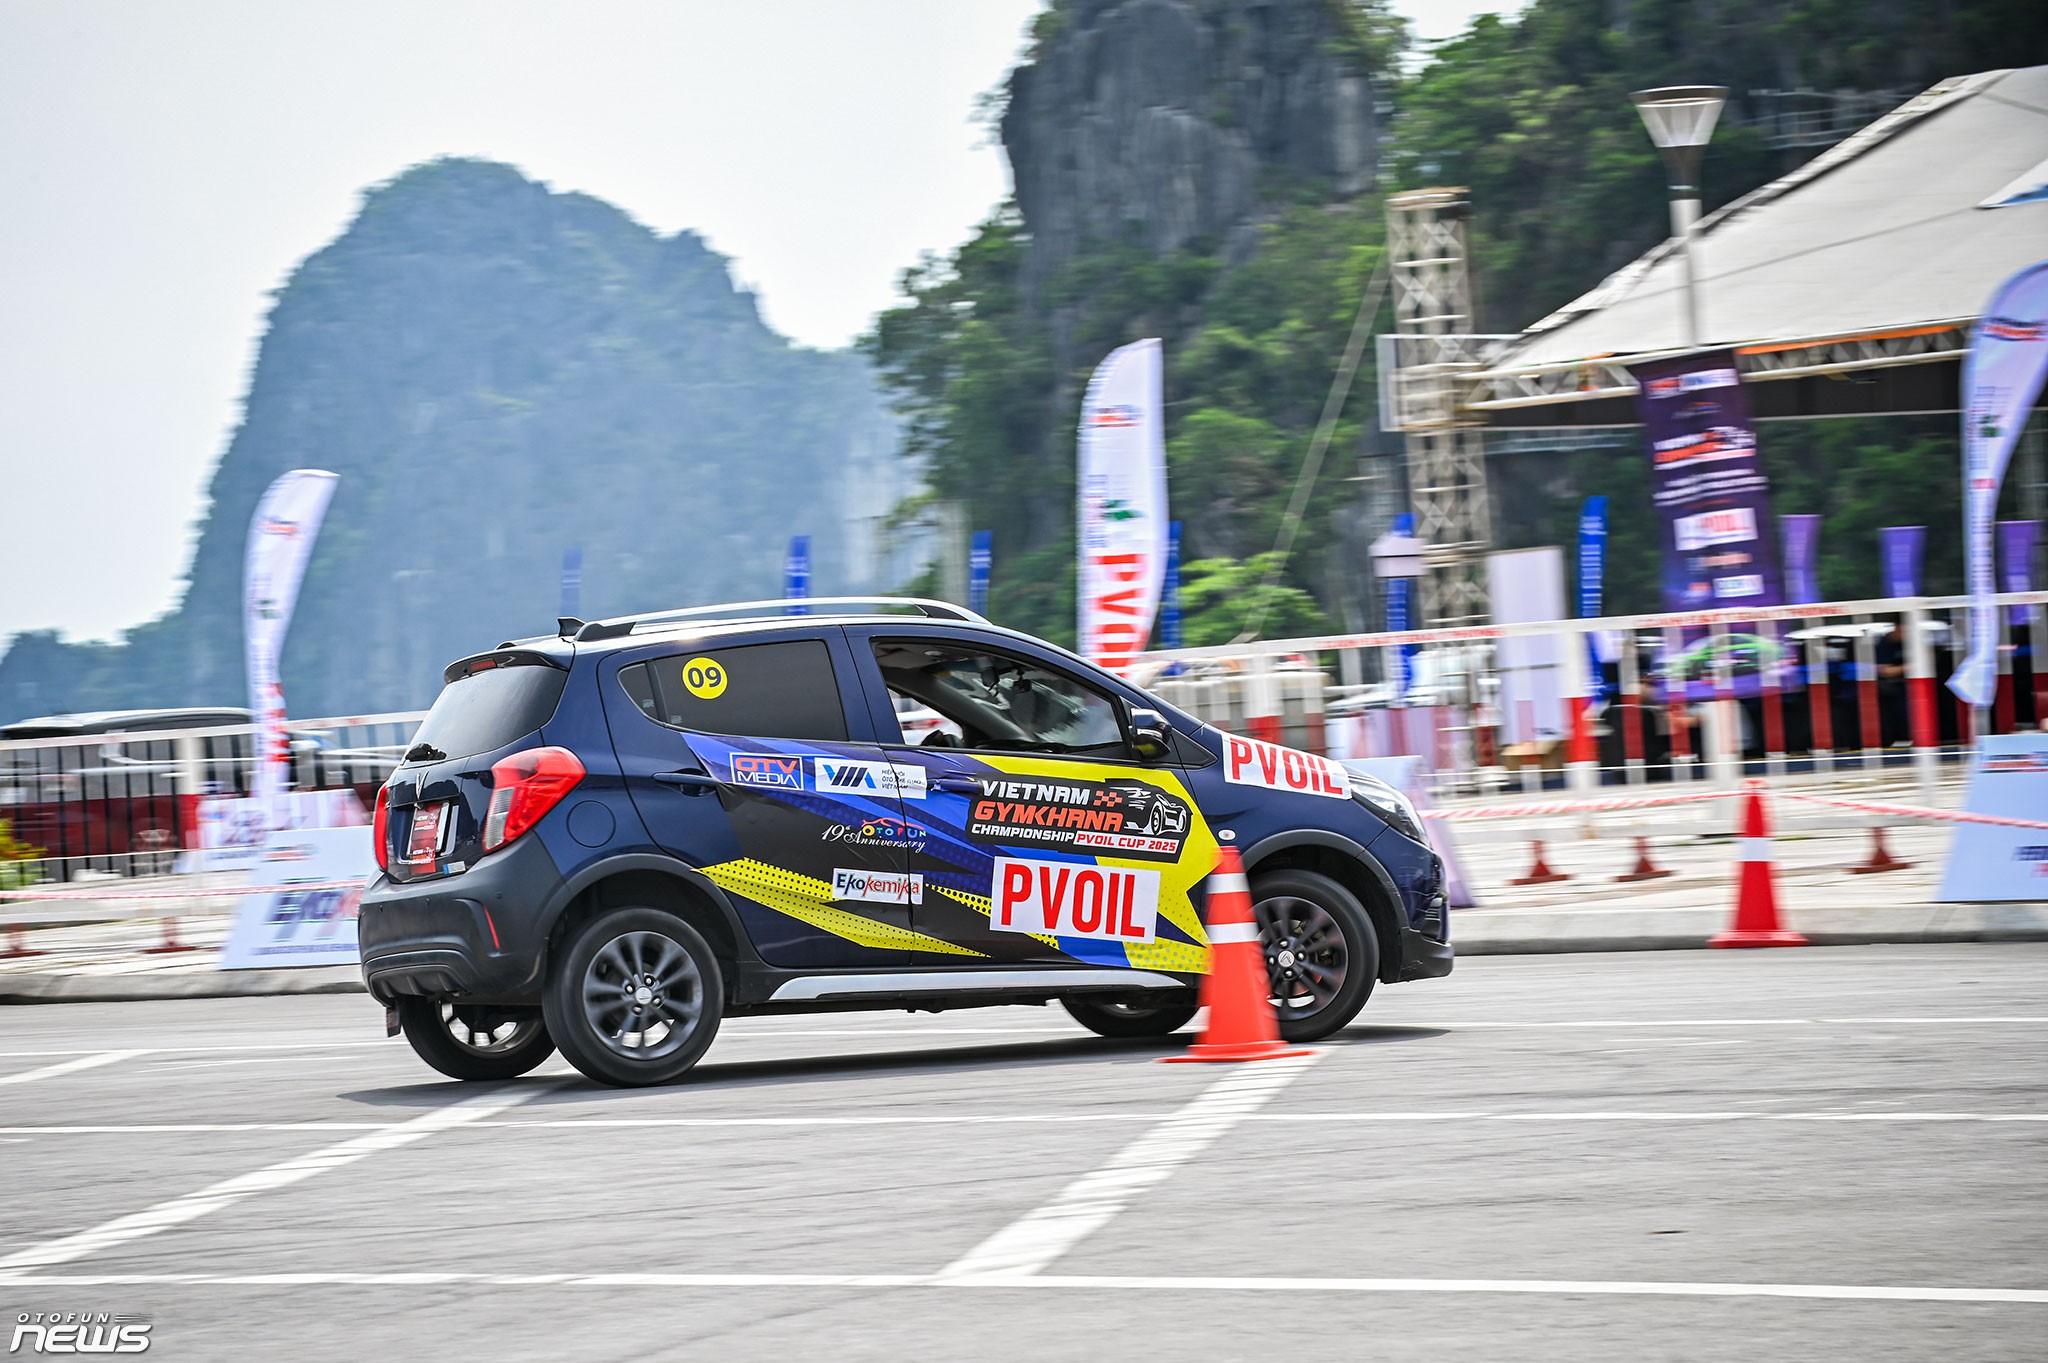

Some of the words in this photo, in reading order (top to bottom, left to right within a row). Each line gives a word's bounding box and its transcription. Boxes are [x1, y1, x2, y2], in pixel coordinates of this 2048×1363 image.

[688, 666, 722, 689] 09
[735, 757, 798, 774] OTV
[1230, 737, 1343, 795] PVOIL
[737, 772, 799, 788] MEDIA
[982, 780, 1091, 805] VIETNAM
[974, 800, 1124, 832] GYMKHANA
[843, 830, 926, 854] Anniversary
[862, 825, 926, 839] OTOFUN
[971, 824, 1075, 843] CHAMPIONSHIP
[1076, 833, 1115, 846] PVOIL
[1118, 837, 1146, 849] CUP
[1148, 840, 1177, 852] 2025
[836, 873, 920, 901] Ekokemika
[1001, 863, 1146, 938] PVOIL
